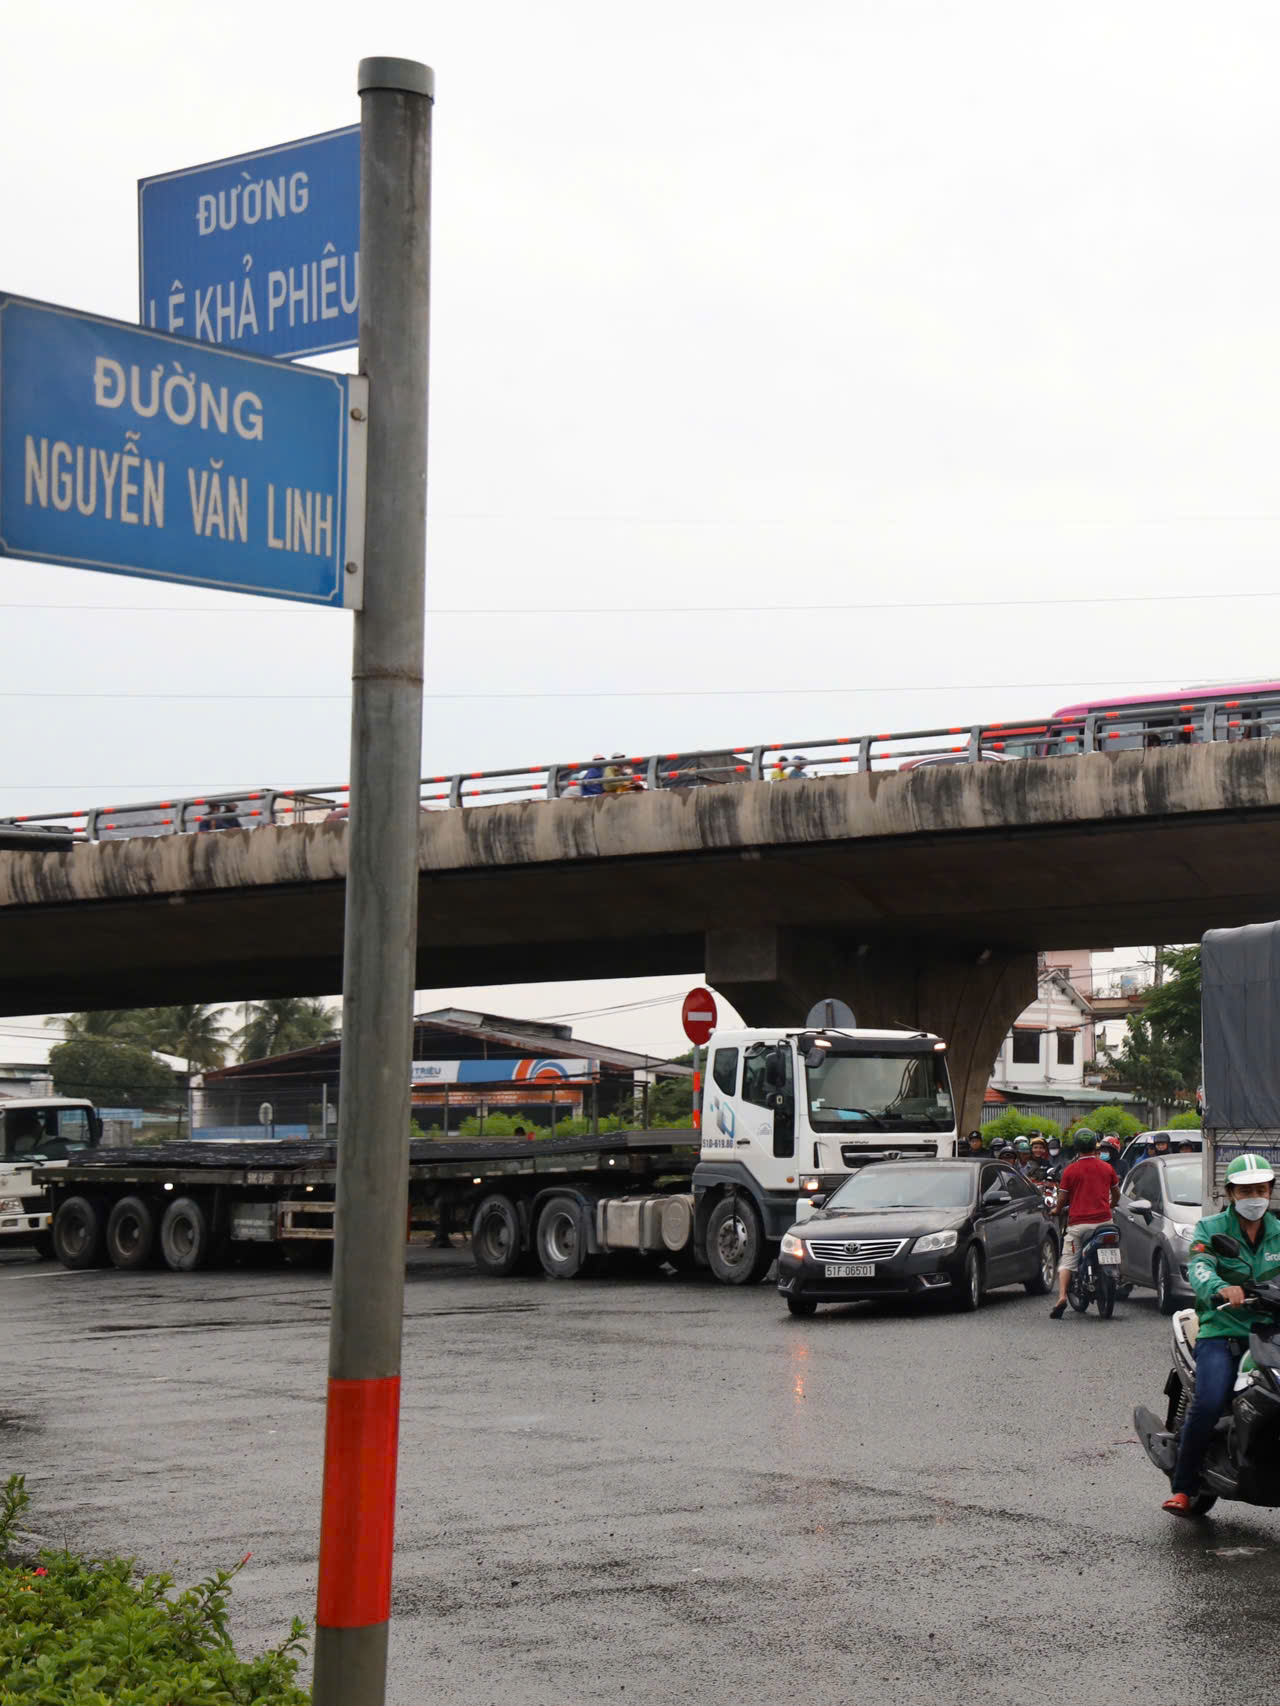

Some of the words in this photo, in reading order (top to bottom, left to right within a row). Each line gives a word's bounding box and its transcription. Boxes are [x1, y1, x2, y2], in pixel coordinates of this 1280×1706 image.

[196, 171, 309, 236] ĐƯỜNG
[195, 254, 259, 343] KHẢ
[268, 242, 359, 332] PHIÊU
[93, 356, 264, 440] ĐƯỜNG
[25, 431, 165, 528] NGUYỄN
[187, 458, 248, 543] VĂN
[267, 483, 334, 557] LINH
